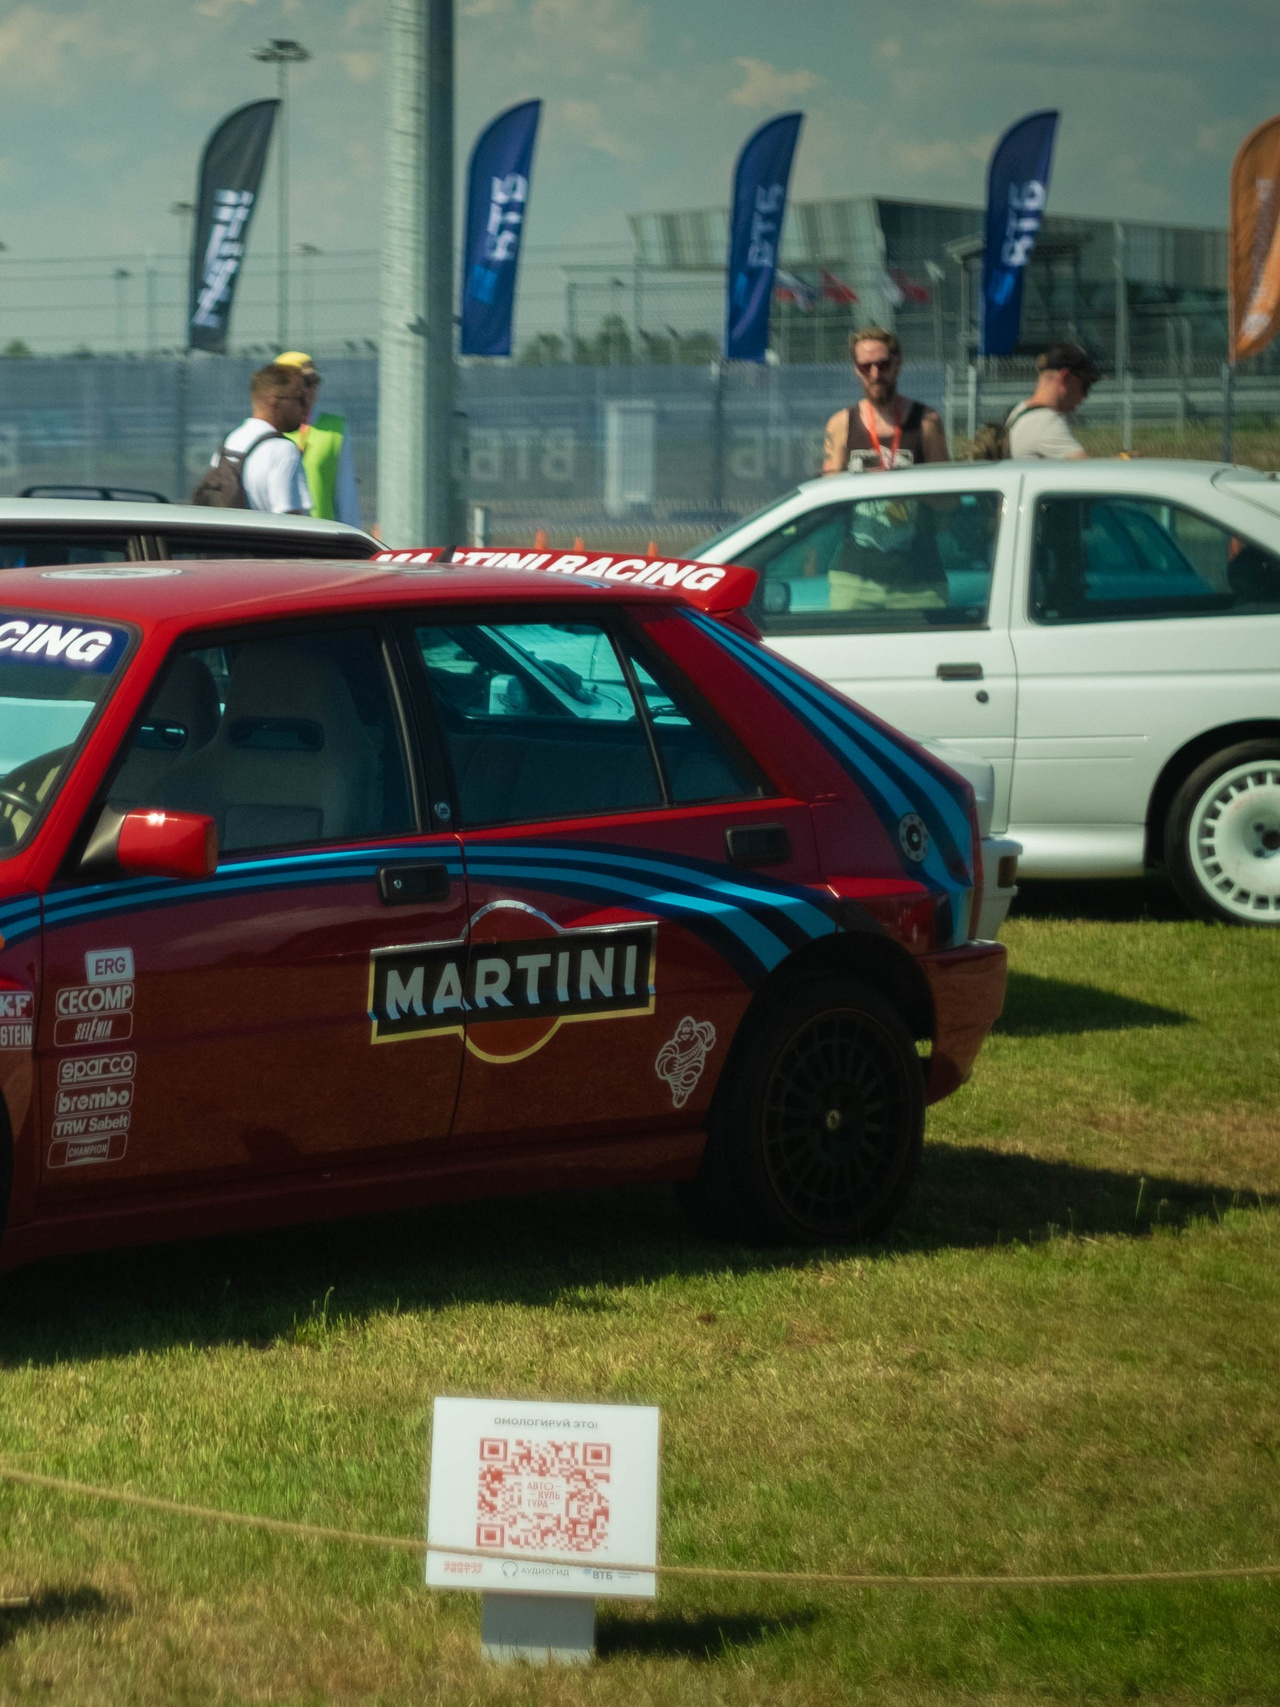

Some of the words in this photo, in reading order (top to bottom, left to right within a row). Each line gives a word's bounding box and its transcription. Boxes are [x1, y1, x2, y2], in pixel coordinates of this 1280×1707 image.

[486, 171, 529, 262] ВТБ
[747, 181, 786, 268] ВТБ
[1000, 178, 1047, 267] ВТБ
[546, 554, 726, 591] RACING
[95, 957, 126, 976] ERG
[385, 944, 638, 1021] MARTINI
[58, 985, 133, 1014] CECOMP
[58, 1087, 130, 1114] brembo
[55, 1120, 87, 1136] TRW
[88, 1114, 129, 1132] Sabelt
[68, 1143, 108, 1158] CHAMPION
[493, 1417, 570, 1428] ОМОЛОГИРУЙ
[573, 1421, 599, 1429] ЭТО!
[520, 1567, 570, 1577] АУДИОГИД
[592, 1570, 613, 1580] ВТБ
